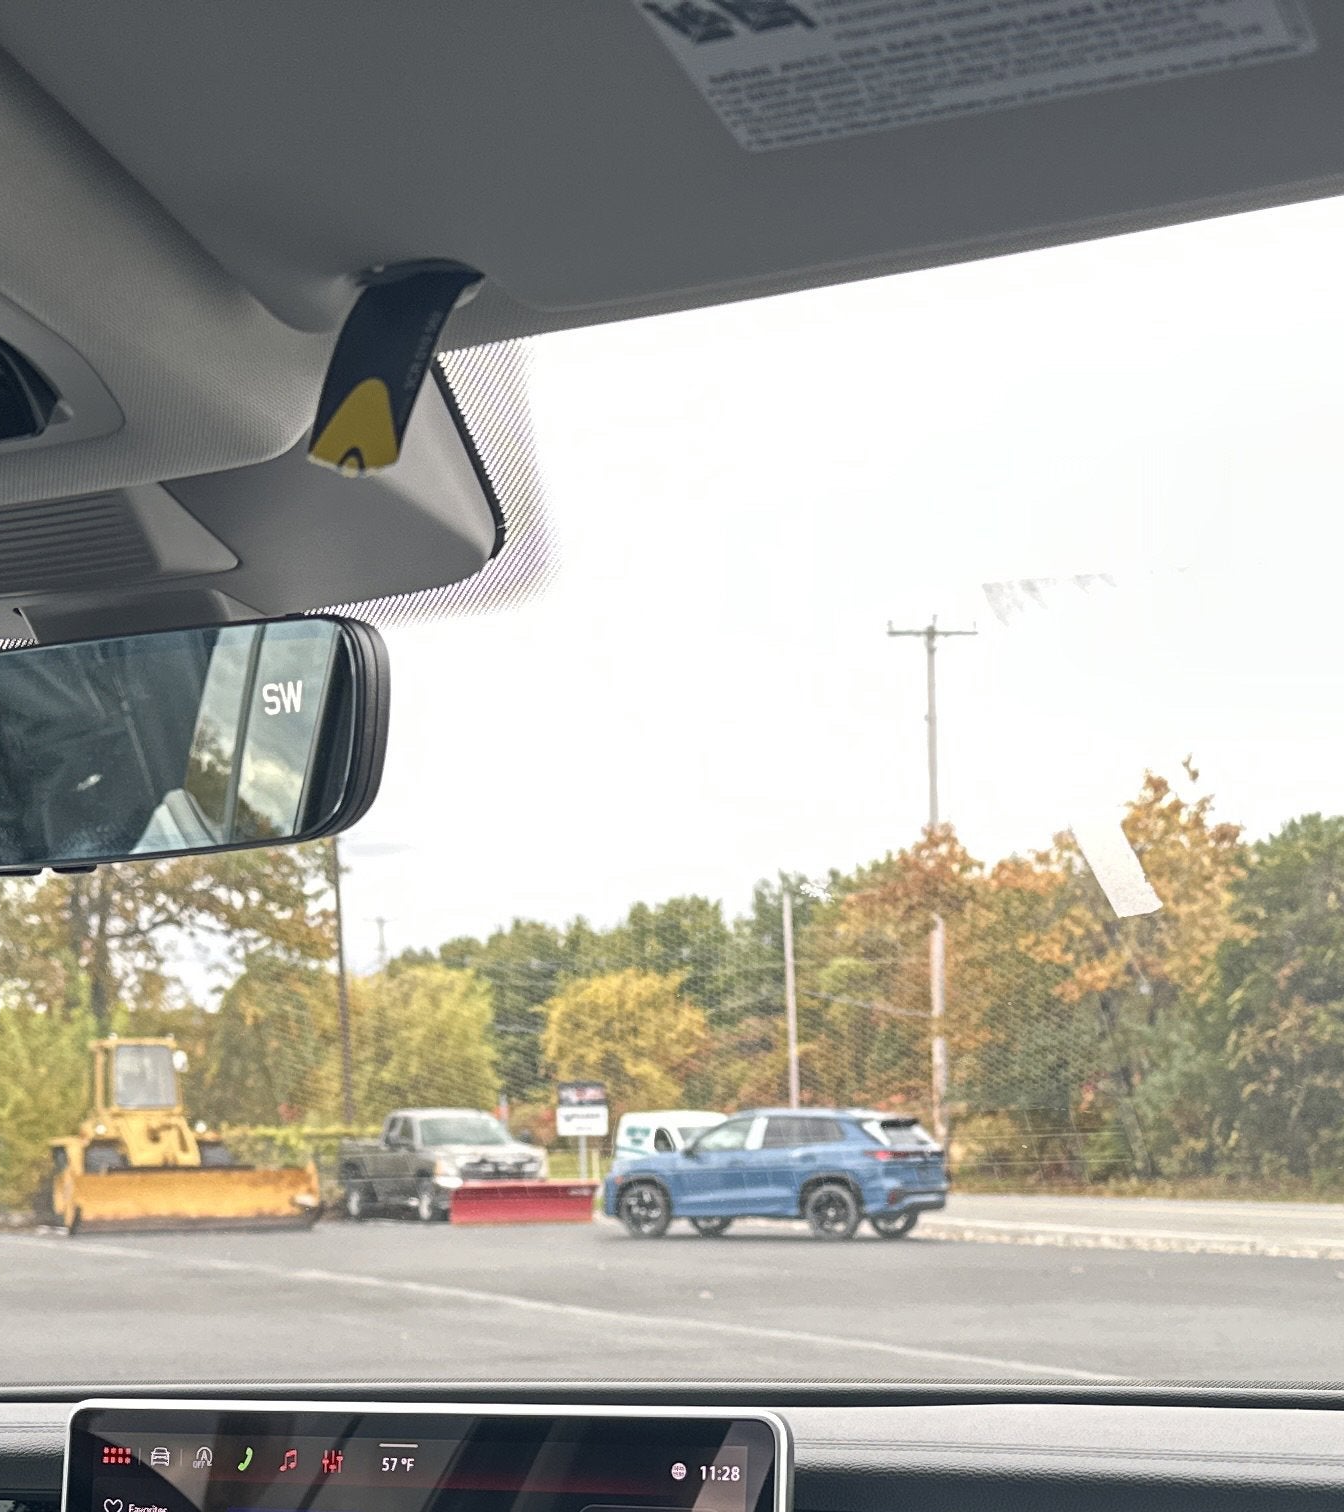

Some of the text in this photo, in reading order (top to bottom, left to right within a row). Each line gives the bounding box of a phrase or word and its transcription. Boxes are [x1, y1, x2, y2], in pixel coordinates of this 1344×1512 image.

[262, 680, 303, 716] SW
[381, 1457, 398, 1472] 57
[699, 1465, 741, 1481] 11:28
